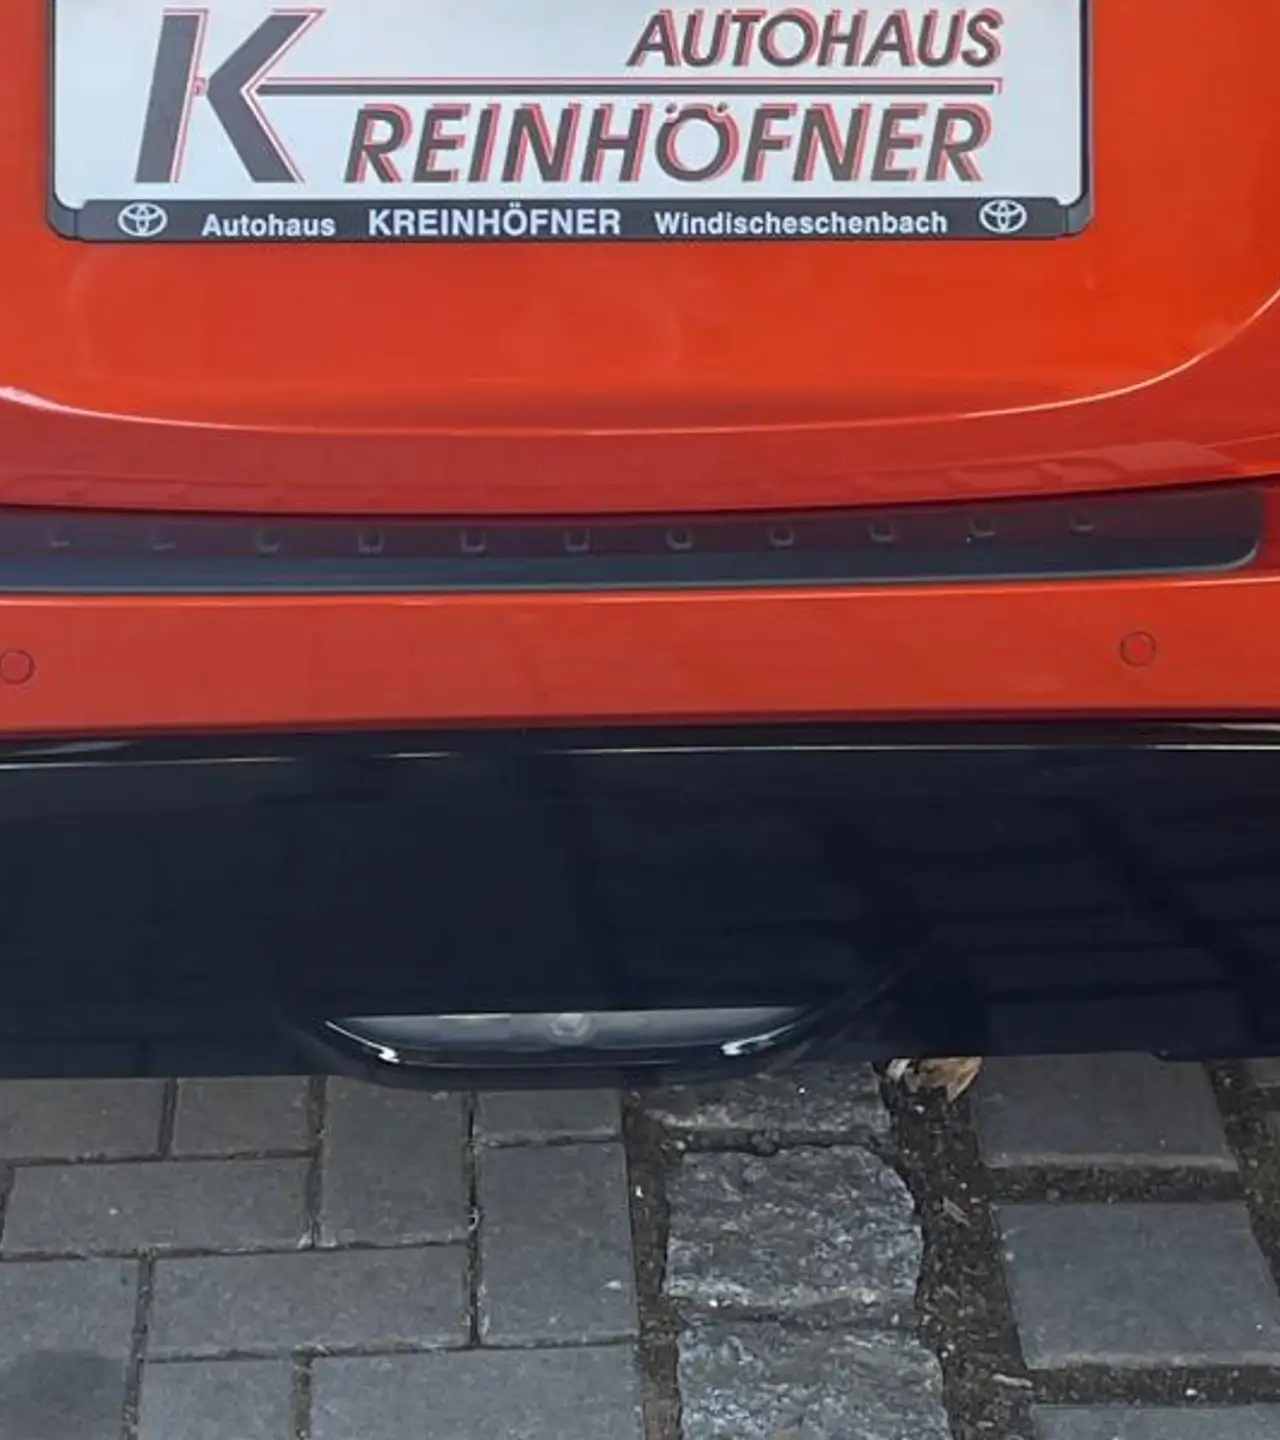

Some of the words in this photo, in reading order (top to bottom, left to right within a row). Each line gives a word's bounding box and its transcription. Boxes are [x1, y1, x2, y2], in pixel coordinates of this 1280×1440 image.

[625, 6, 1005, 68] AUTOHAUS
[343, 101, 993, 185] REINHÖFNER
[201, 212, 337, 238] Autohaus
[368, 201, 621, 238] KREINHÖFNER
[654, 209, 948, 236] Windischeschenbach
